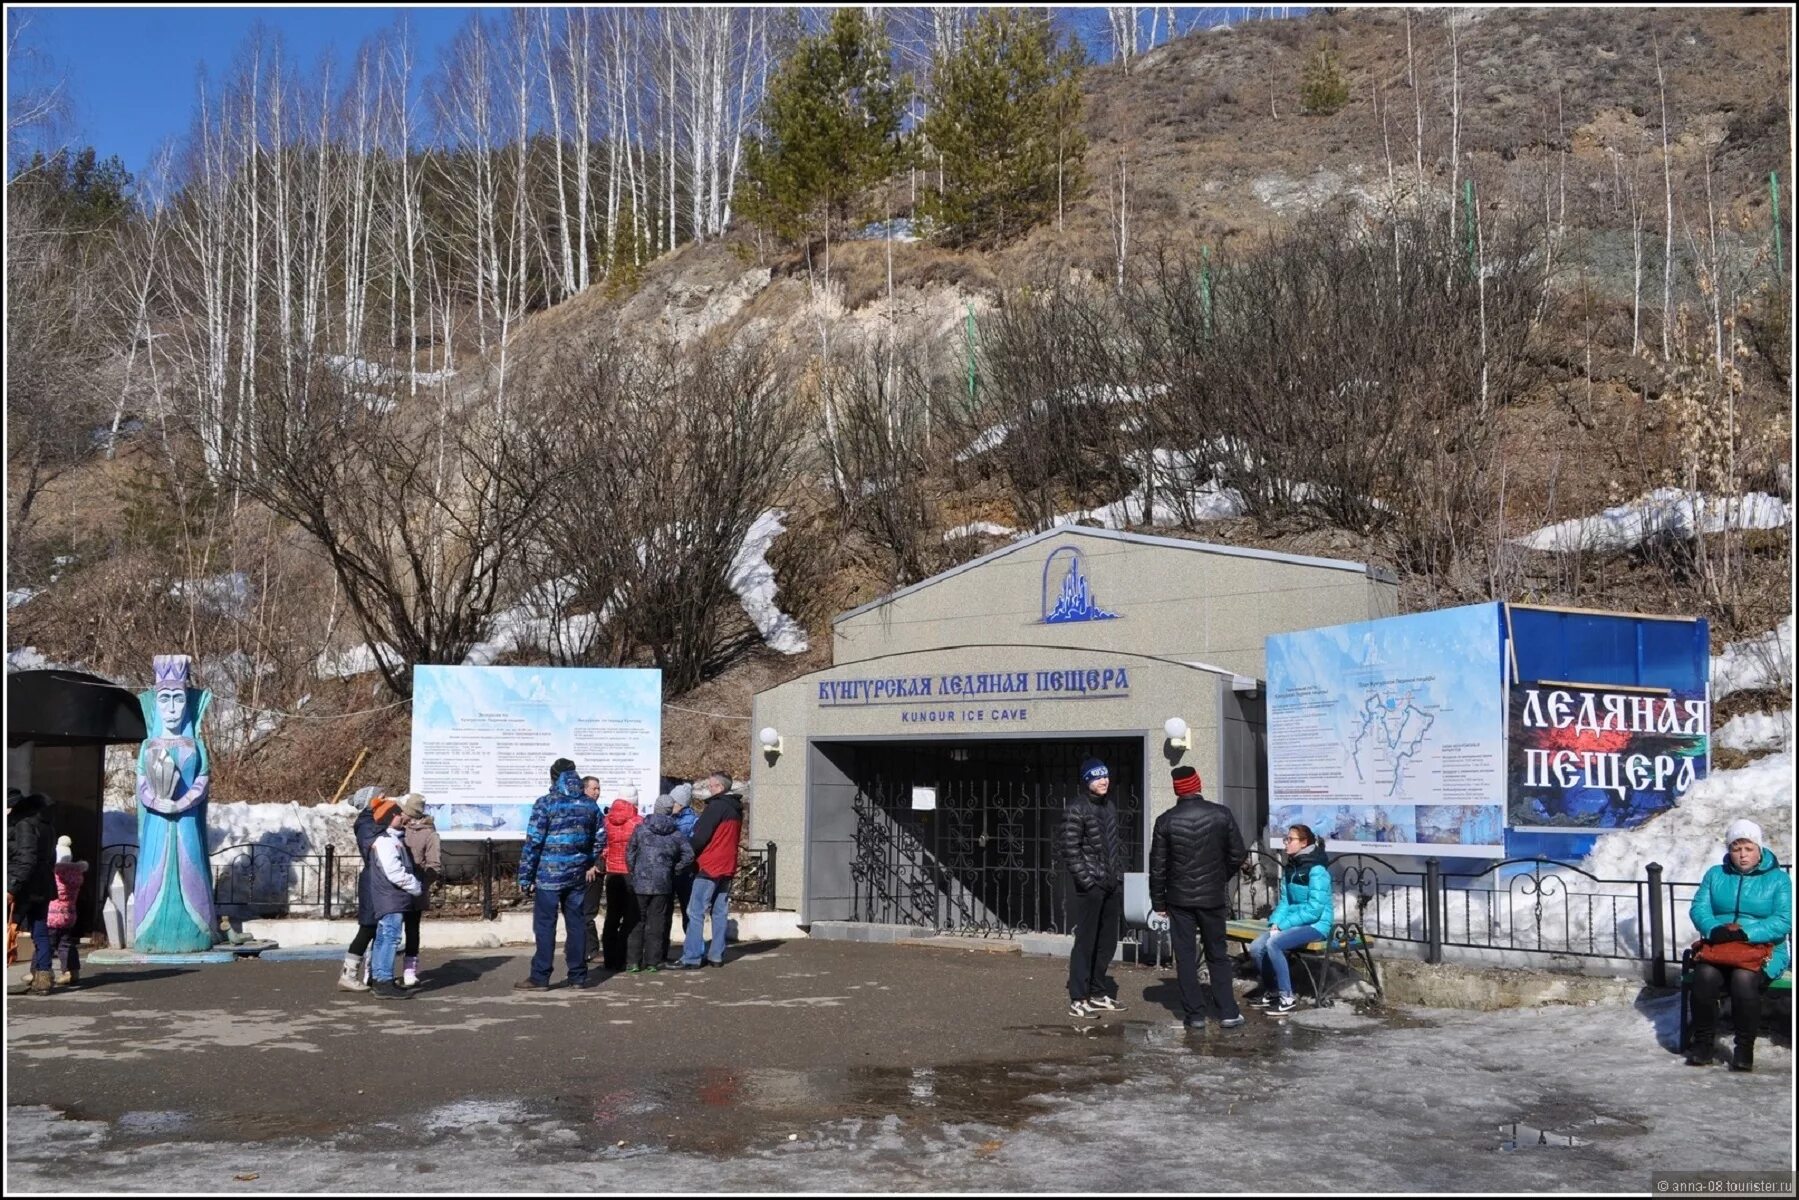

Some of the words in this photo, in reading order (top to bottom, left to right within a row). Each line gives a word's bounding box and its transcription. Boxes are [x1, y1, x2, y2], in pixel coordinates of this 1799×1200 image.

[818, 677, 932, 704] КУНГУРСКАЯ
[938, 672, 1028, 695] ЛЕДЯНАЯ
[1036, 667, 1129, 694] ПЕЩЕРА
[901, 710, 955, 722] KUNGUR
[962, 710, 984, 721] ICE
[991, 709, 1028, 720] CAVE
[1522, 689, 1707, 738] ЛЕДЯНАЯ
[1523, 748, 1696, 801] ПЕЩЕРА
